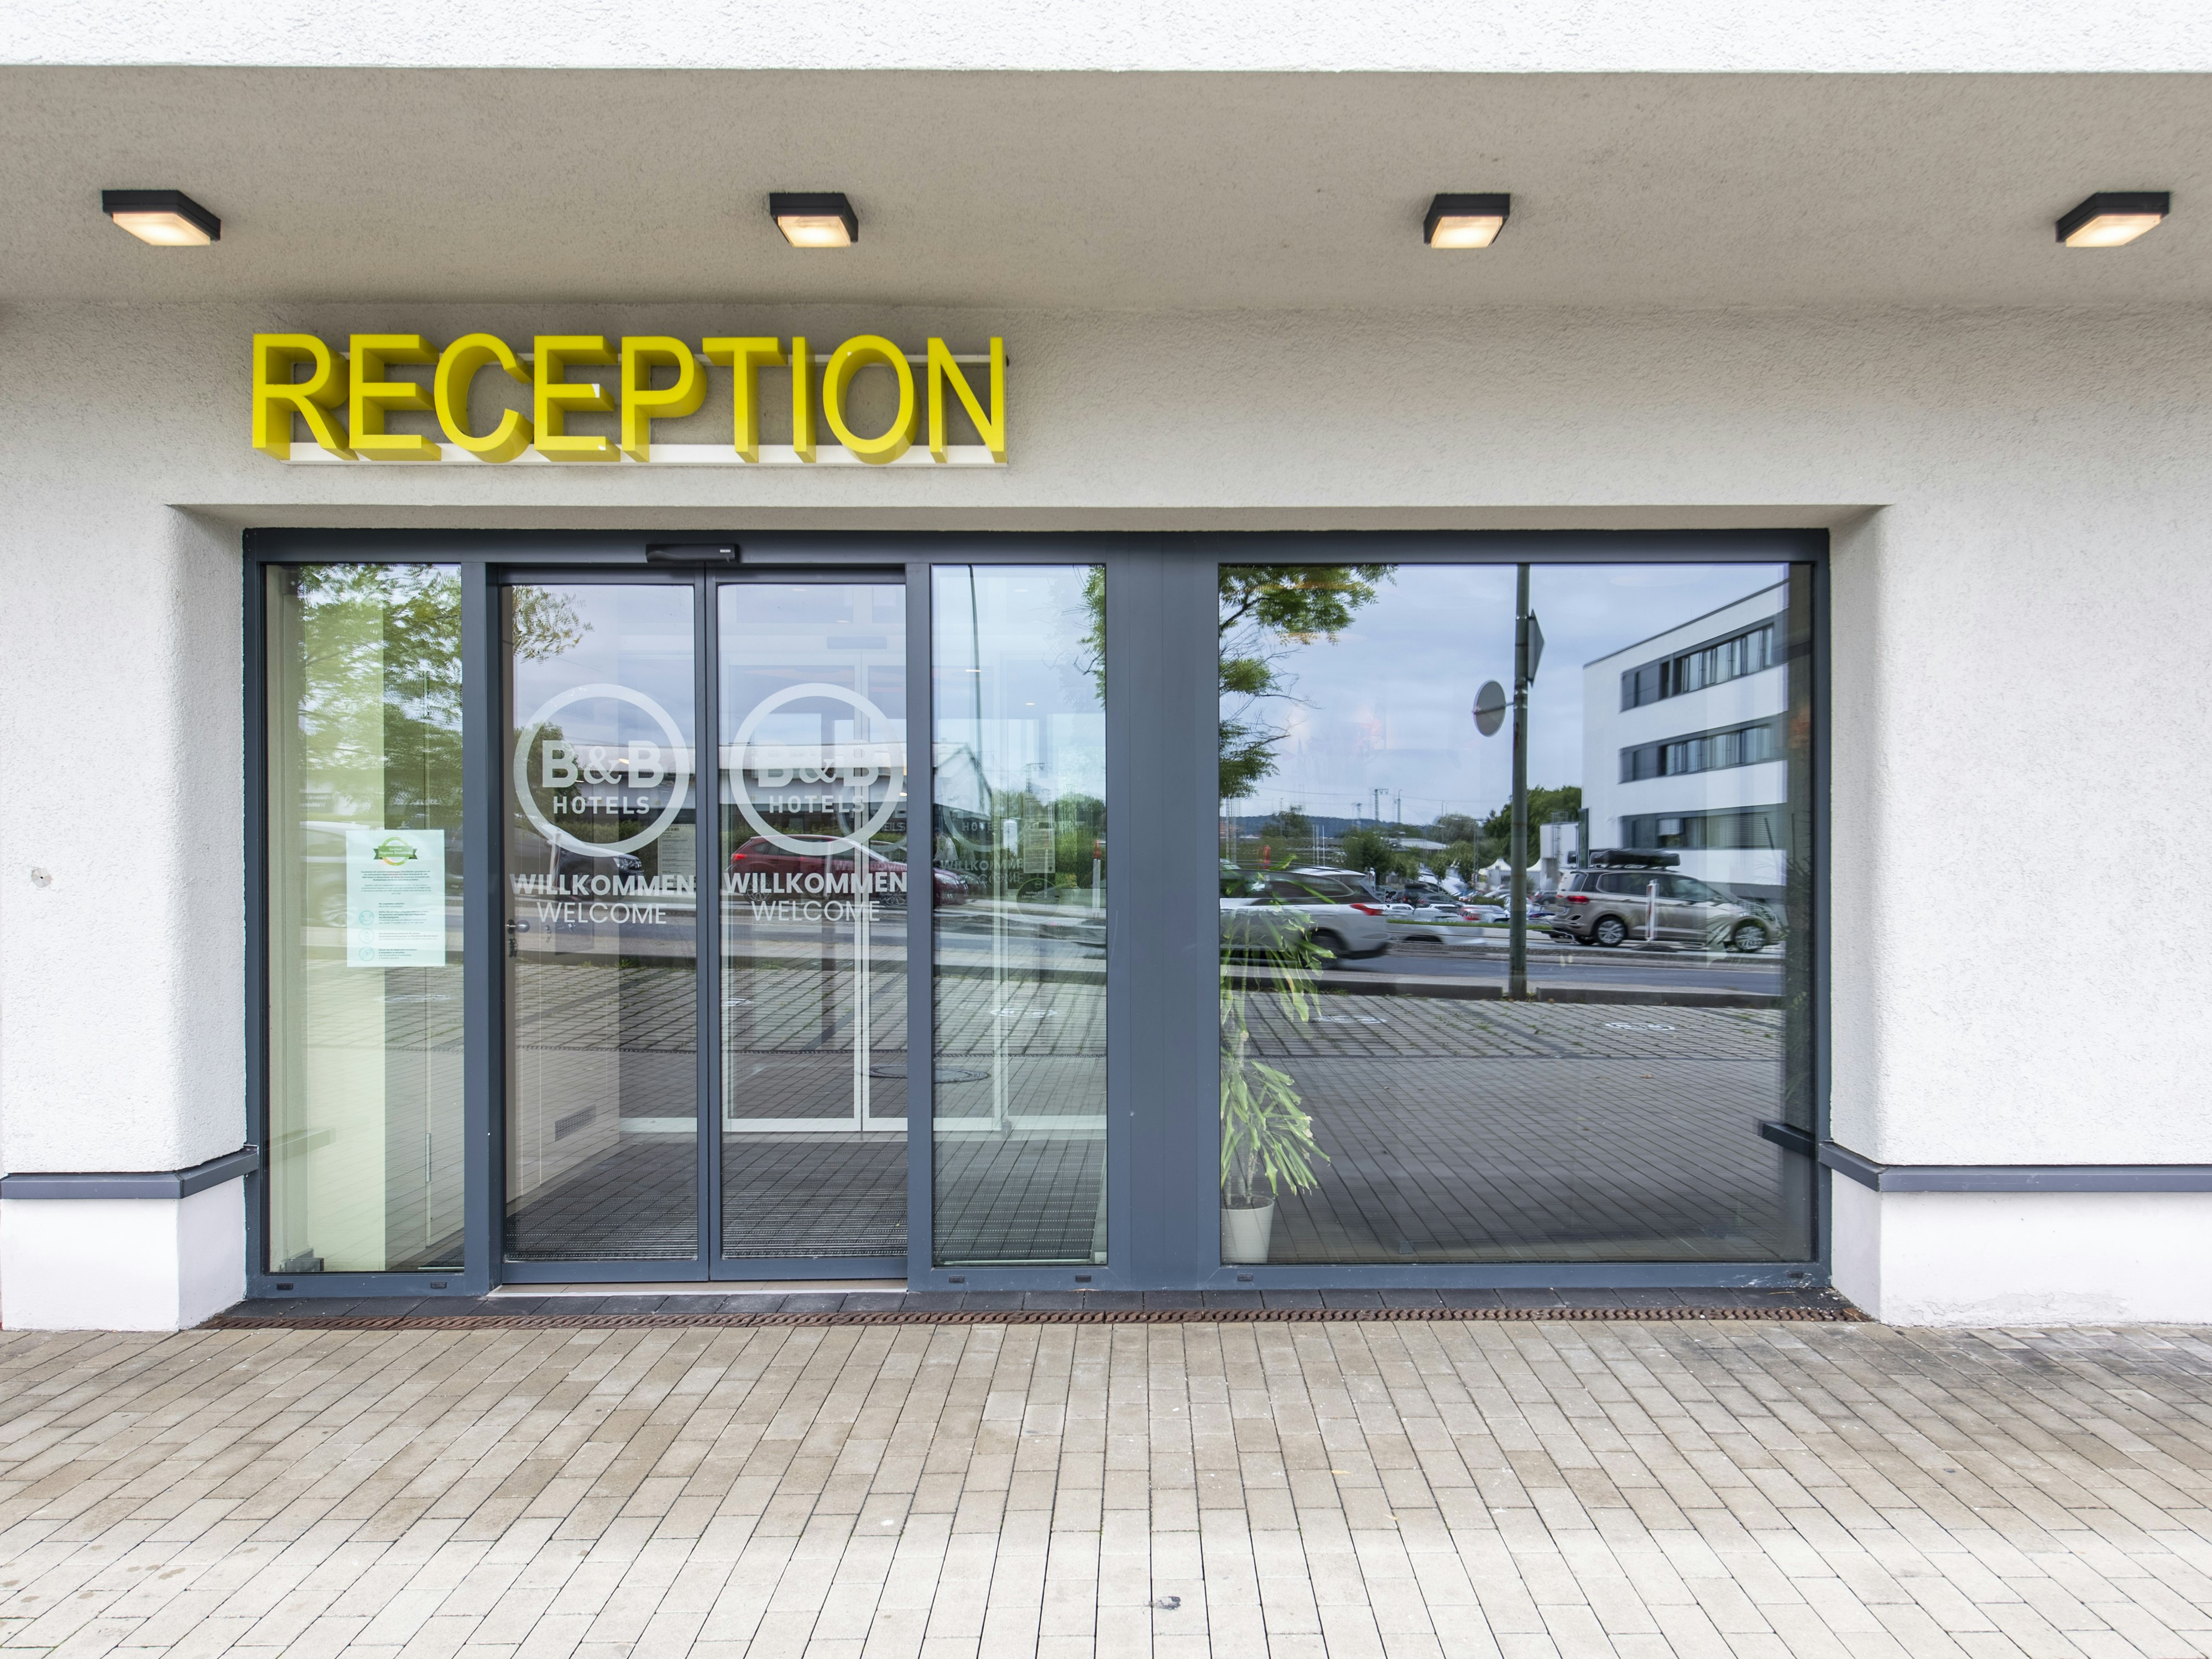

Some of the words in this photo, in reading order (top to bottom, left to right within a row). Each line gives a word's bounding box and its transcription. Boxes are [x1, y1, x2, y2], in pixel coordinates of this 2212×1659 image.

[253, 333, 1005, 463] RECEPTION
[542, 740, 664, 788] B&B
[758, 739, 879, 787] B&B
[553, 796, 650, 815] HOTELS
[769, 795, 865, 813] HOTELS
[509, 874, 696, 896] WILLKOMMEN
[723, 872, 907, 894] WILLKOMMEN
[537, 902, 667, 924] WELCOME
[752, 900, 880, 922] WELCOME
